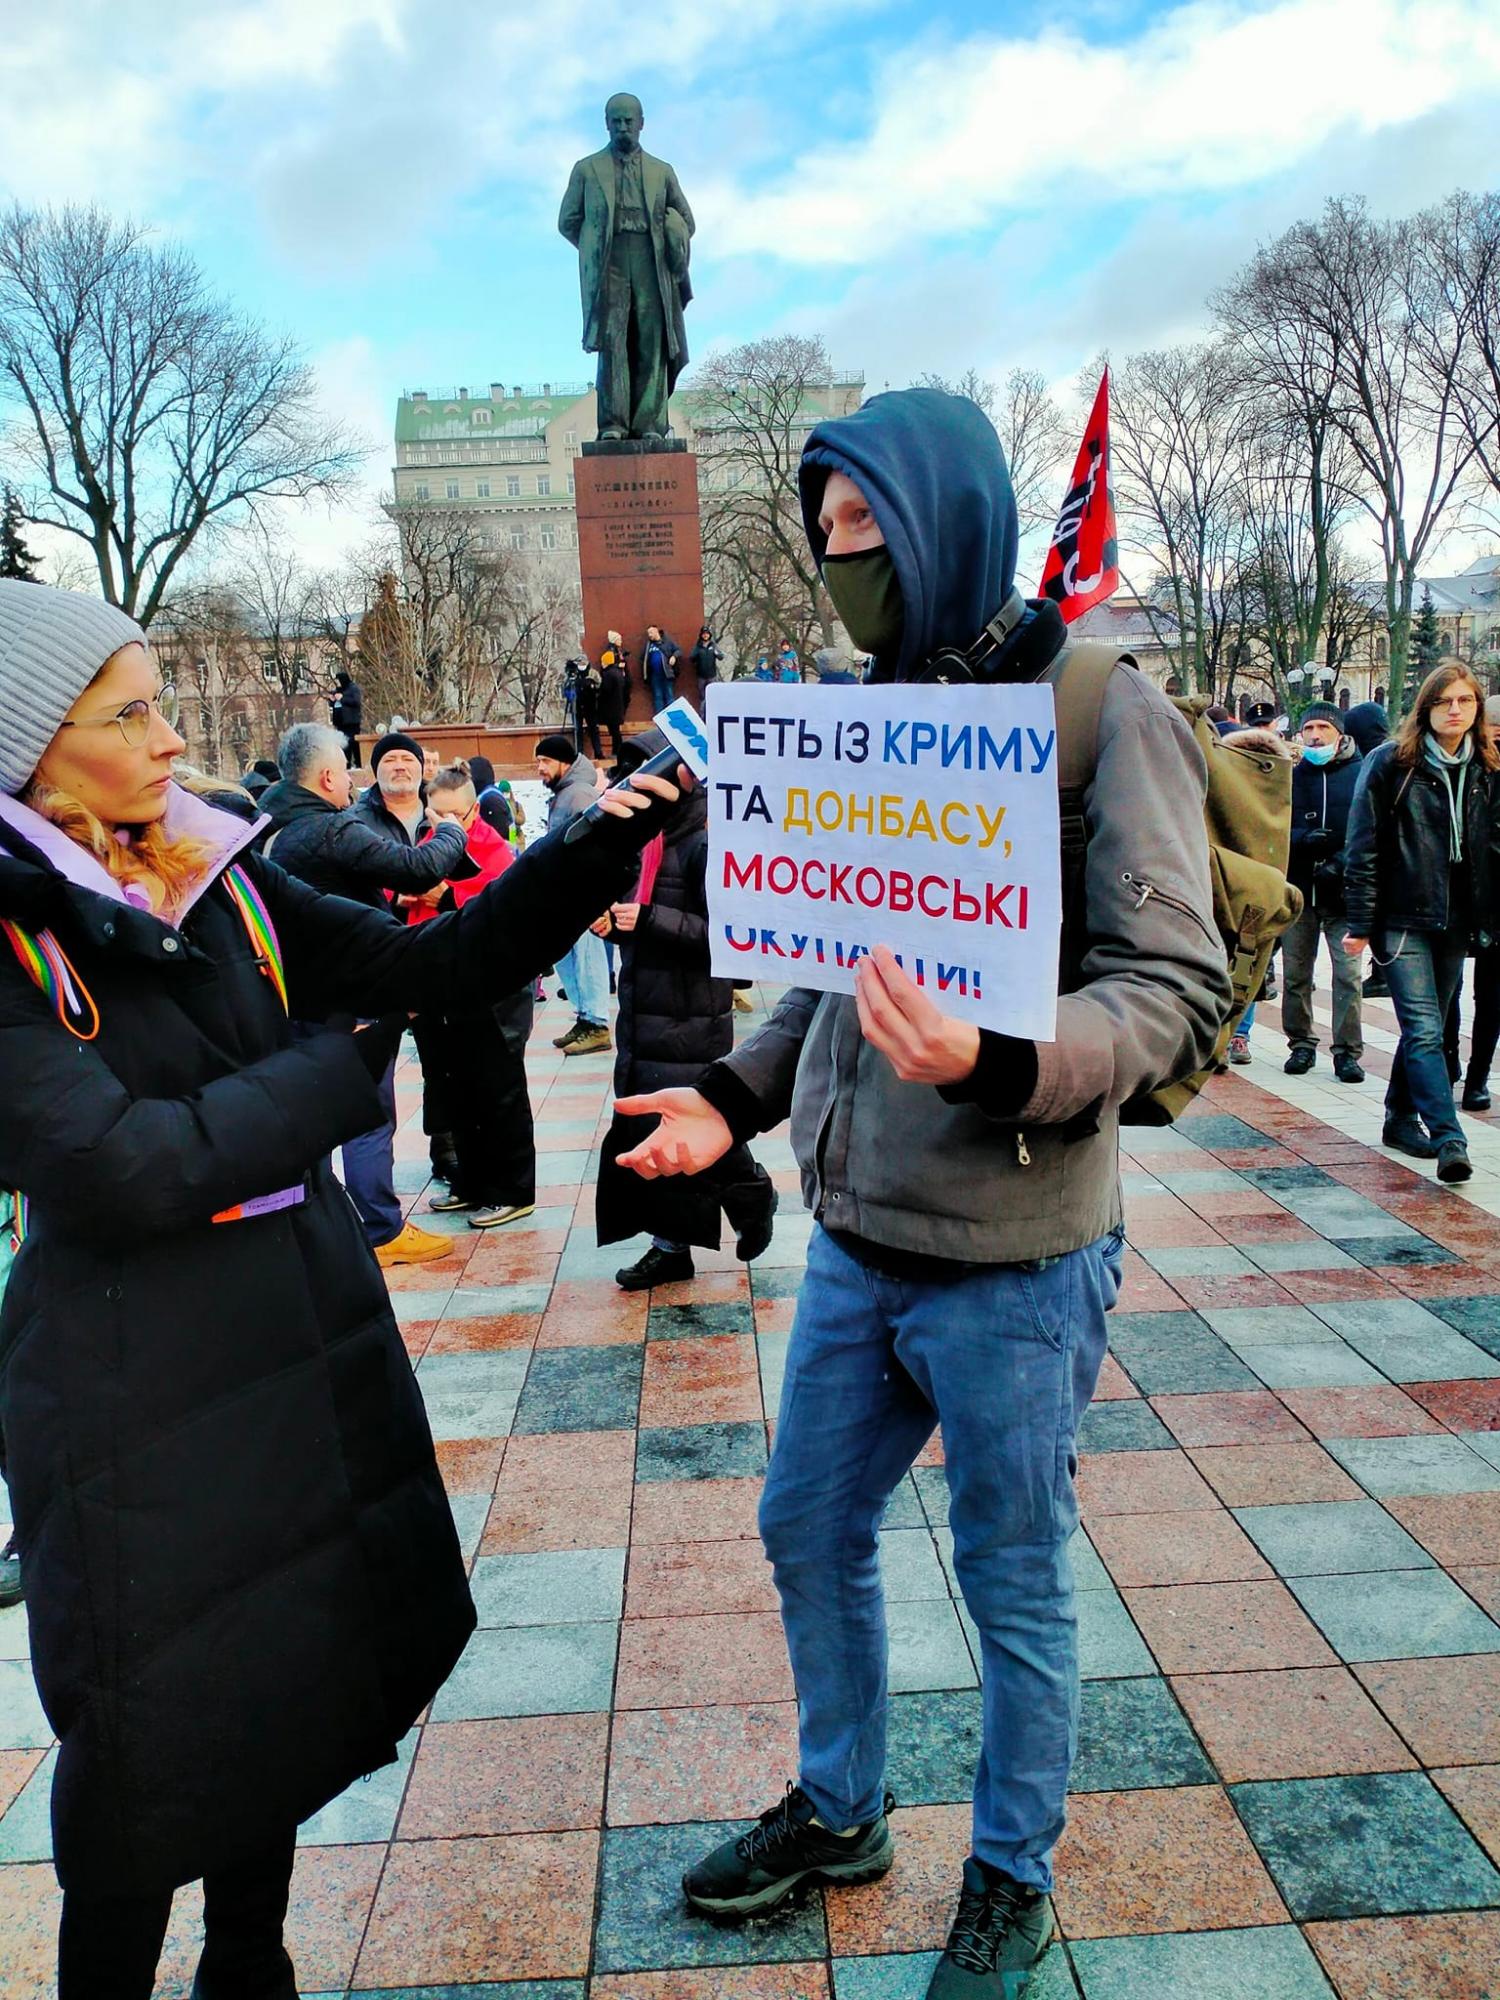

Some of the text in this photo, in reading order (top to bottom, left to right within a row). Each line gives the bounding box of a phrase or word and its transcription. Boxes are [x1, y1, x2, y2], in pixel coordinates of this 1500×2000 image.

[716, 716, 823, 759] ГЕТЬ
[835, 721, 870, 764] ІЗ
[883, 720, 1055, 774] КРИМУ
[716, 783, 1012, 858] ТА ДОНБАСУ,
[722, 851, 1028, 930] МОСКОВСЬКІ
[724, 924, 982, 1000] ОКУПАТИ!
